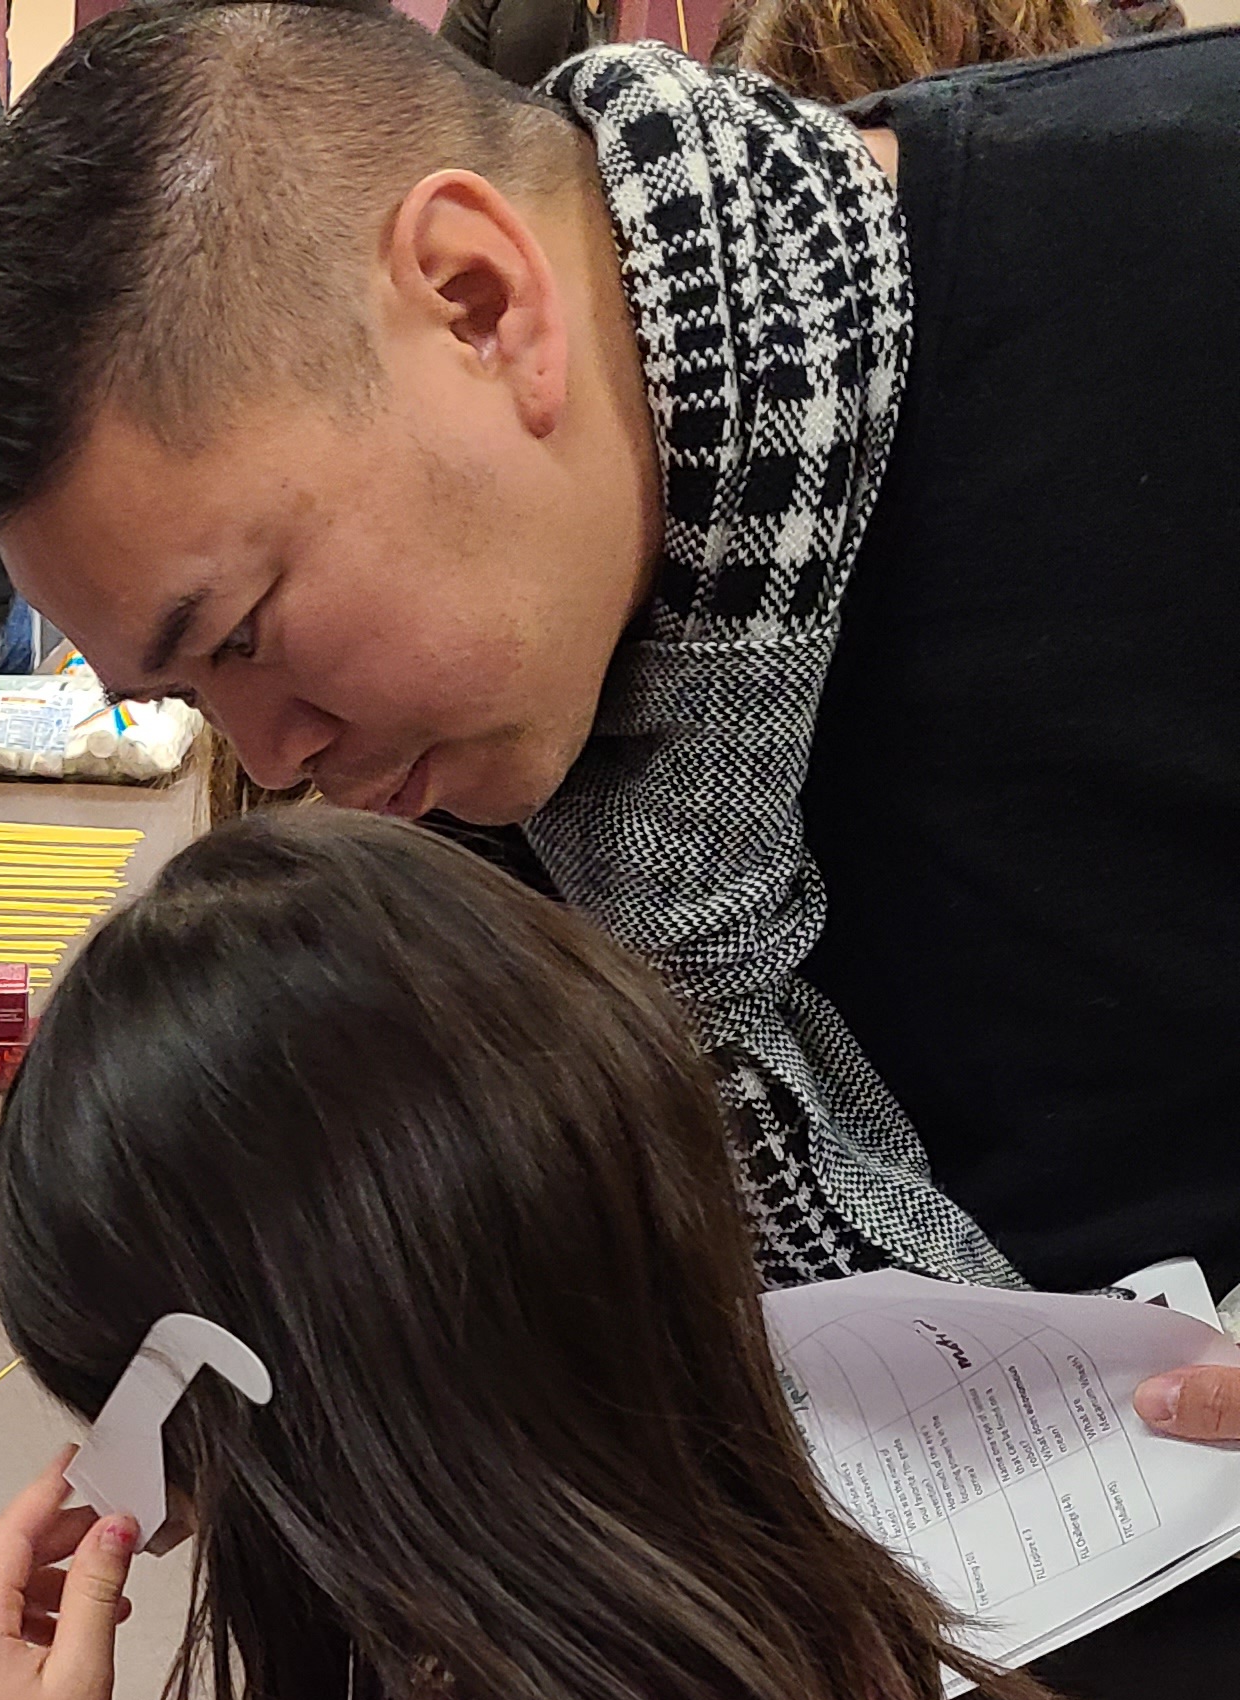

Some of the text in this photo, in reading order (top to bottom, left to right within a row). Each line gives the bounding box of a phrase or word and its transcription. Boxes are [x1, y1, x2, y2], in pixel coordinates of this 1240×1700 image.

[1074, 1398, 1096, 1439] What are
[1086, 1388, 1110, 1431] Mecanum
[1037, 1436, 1053, 1461] What
[1047, 1425, 1067, 1452] mean?
[1011, 1455, 1024, 1474] that
